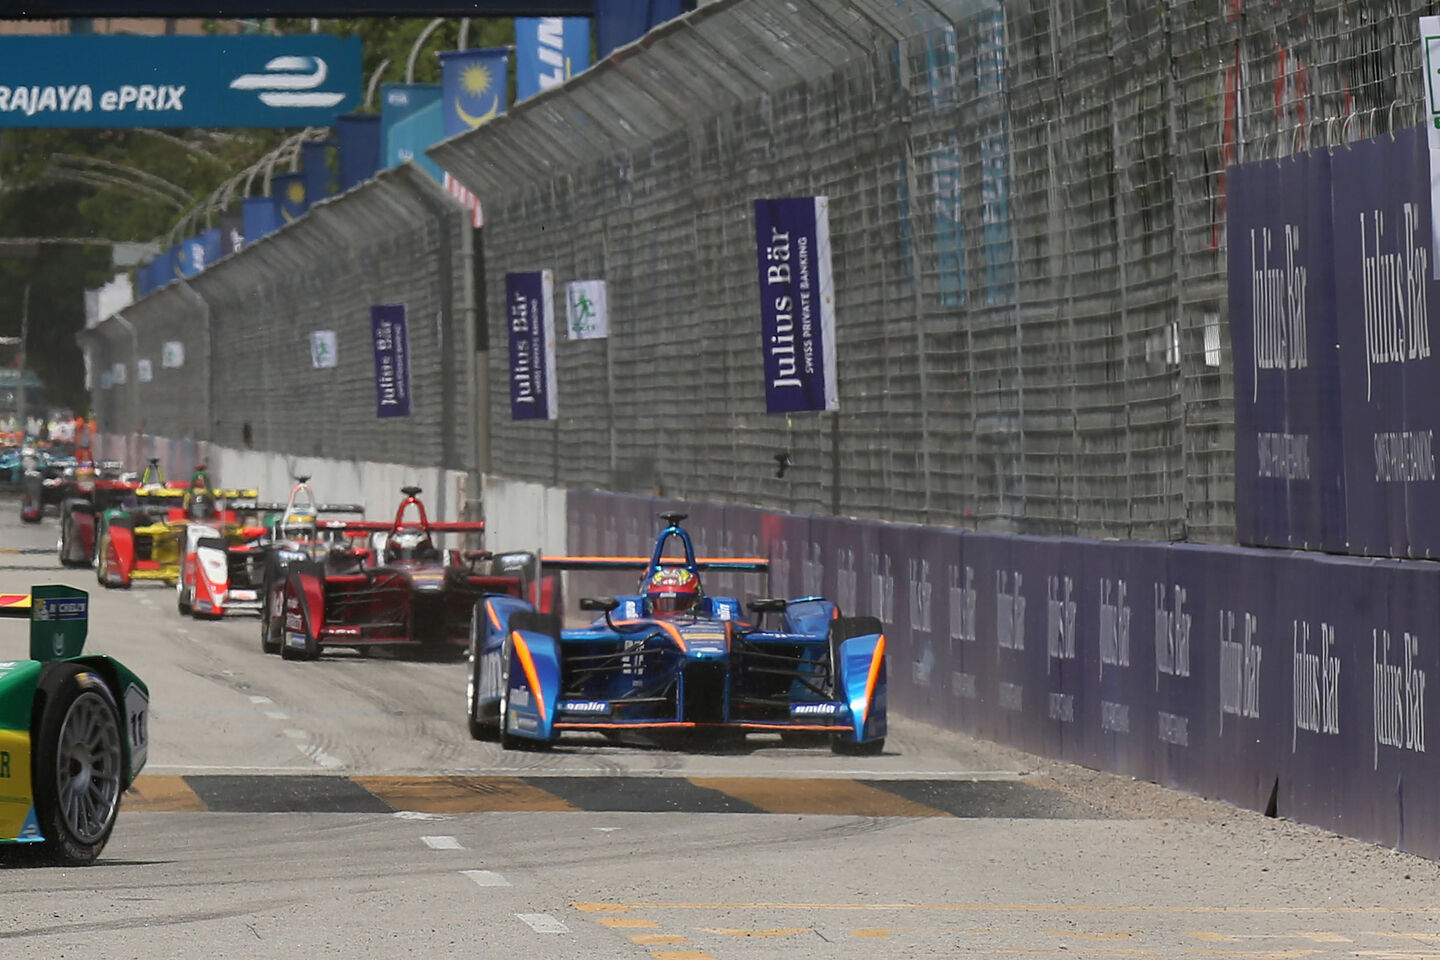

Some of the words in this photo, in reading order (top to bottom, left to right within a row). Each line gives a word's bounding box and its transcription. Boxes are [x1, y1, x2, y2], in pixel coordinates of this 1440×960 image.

[99, 85, 186, 111] ePRIX
[767, 226, 792, 285] Bär
[797, 236, 810, 290] BANKING
[512, 291, 529, 332] Bär
[800, 292, 812, 339] PRIVATE
[1251, 227, 1288, 403] Julius
[1285, 224, 1308, 369] Bär
[1360, 210, 1407, 402] Julius
[1404, 202, 1431, 359] Bär
[514, 340, 536, 403] Julius
[771, 295, 802, 388] Julius
[802, 341, 814, 374] SWISS
[1291, 619, 1320, 754] Julius
[1321, 622, 1341, 735] Bär
[1373, 628, 1403, 771] Julius
[1404, 632, 1426, 753] Bär
